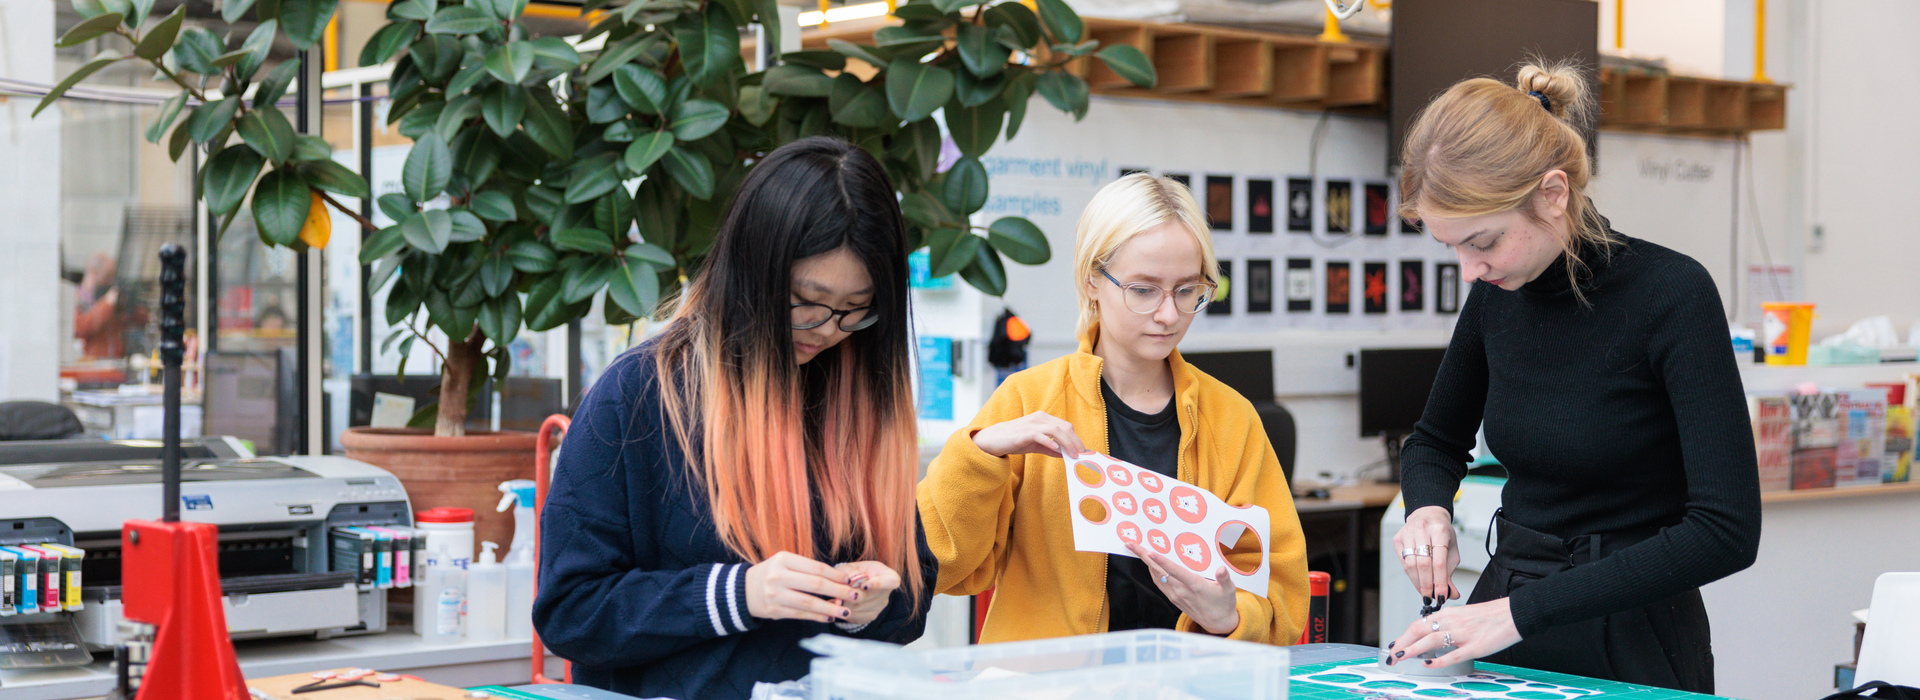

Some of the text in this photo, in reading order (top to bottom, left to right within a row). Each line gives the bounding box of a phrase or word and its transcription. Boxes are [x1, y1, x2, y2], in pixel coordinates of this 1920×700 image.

[984, 155, 1107, 185] garment vinyl
[1674, 158, 1713, 183] Cutter
[984, 192, 1060, 216] samples
[1314, 617, 1325, 632] 2D
